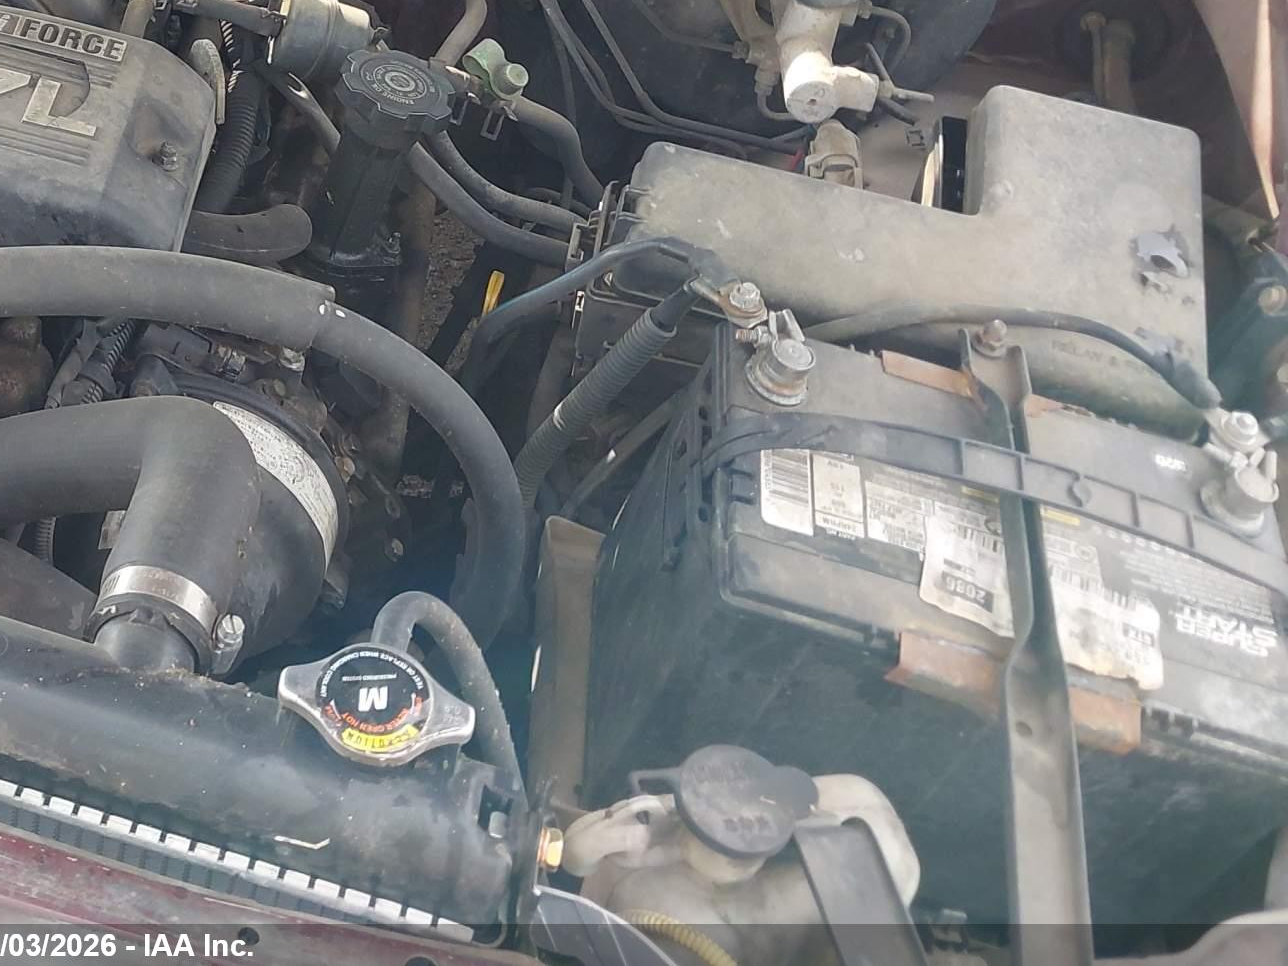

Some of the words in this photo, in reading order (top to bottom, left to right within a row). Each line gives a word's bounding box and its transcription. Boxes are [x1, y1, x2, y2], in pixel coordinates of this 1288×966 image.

[20, 18, 125, 60] FORCE
[1173, 604, 1278, 647] START
[1176, 617, 1269, 657] SUPER
[380, 652, 409, 670] REPLACE
[320, 670, 333, 698] COOLANT
[358, 686, 388, 712] M
